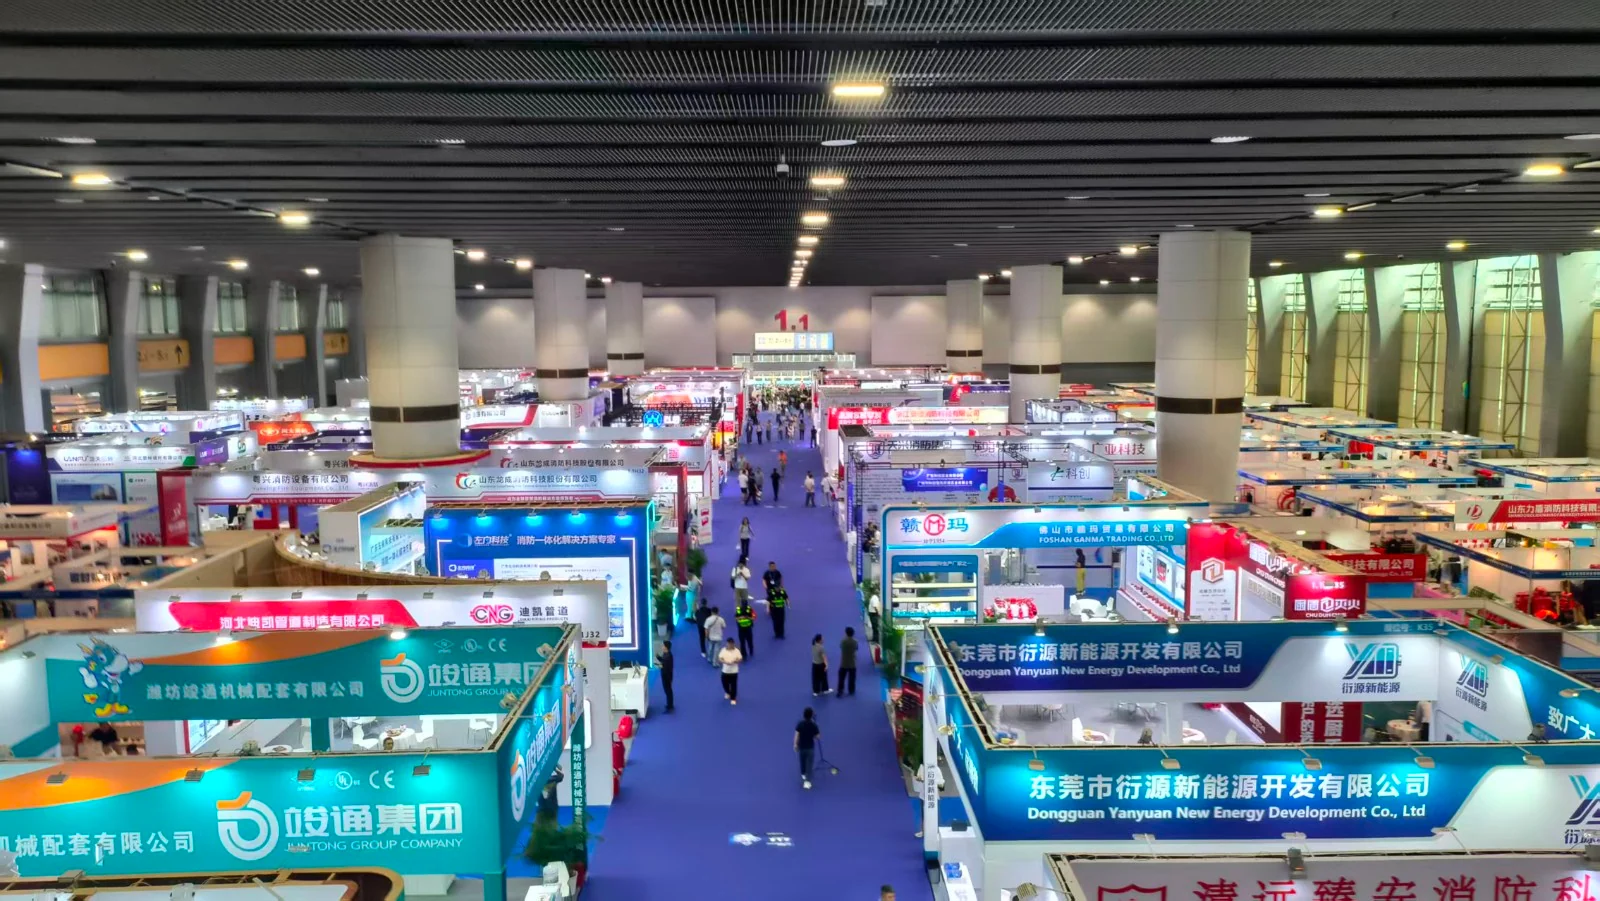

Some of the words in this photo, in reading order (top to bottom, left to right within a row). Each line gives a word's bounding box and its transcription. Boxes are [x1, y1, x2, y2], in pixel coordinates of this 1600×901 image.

[774, 309, 809, 331] 1.1
[1508, 504, 1600, 514] 山东力盾消防科技有限
[947, 518, 969, 532] 玛
[516, 535, 616, 545] 消防一体化解决方案专家
[519, 606, 569, 617] 迪凯管道
[488, 638, 507, 652] CE
[1013, 667, 1059, 677] Yanyuan
[1061, 666, 1086, 675] New
[1088, 666, 1124, 677] Energy
[1127, 665, 1197, 677] Development
[1200, 665, 1220, 675] Co.,
[1223, 664, 1241, 674] Ltd
[427, 689, 474, 697] JUNTONG
[1342, 682, 1401, 694] 衍源新能源
[369, 770, 396, 789] CE
[1029, 773, 1431, 800] 东莞市衍源新能源开发有限公司
[1027, 806, 1105, 820] Dongguan
[1108, 806, 1172, 820] Yanyuan
[1176, 806, 1210, 818] New
[1213, 805, 1265, 820] Energy
[1268, 804, 1367, 820] Development
[1371, 804, 1399, 819] Co.,
[1402, 804, 1426, 817] Ltd
[284, 803, 463, 838] 竣通集团
[285, 841, 347, 852] JUNTONG
[350, 839, 398, 850] GROUP
[400, 838, 463, 849] COMPANY
